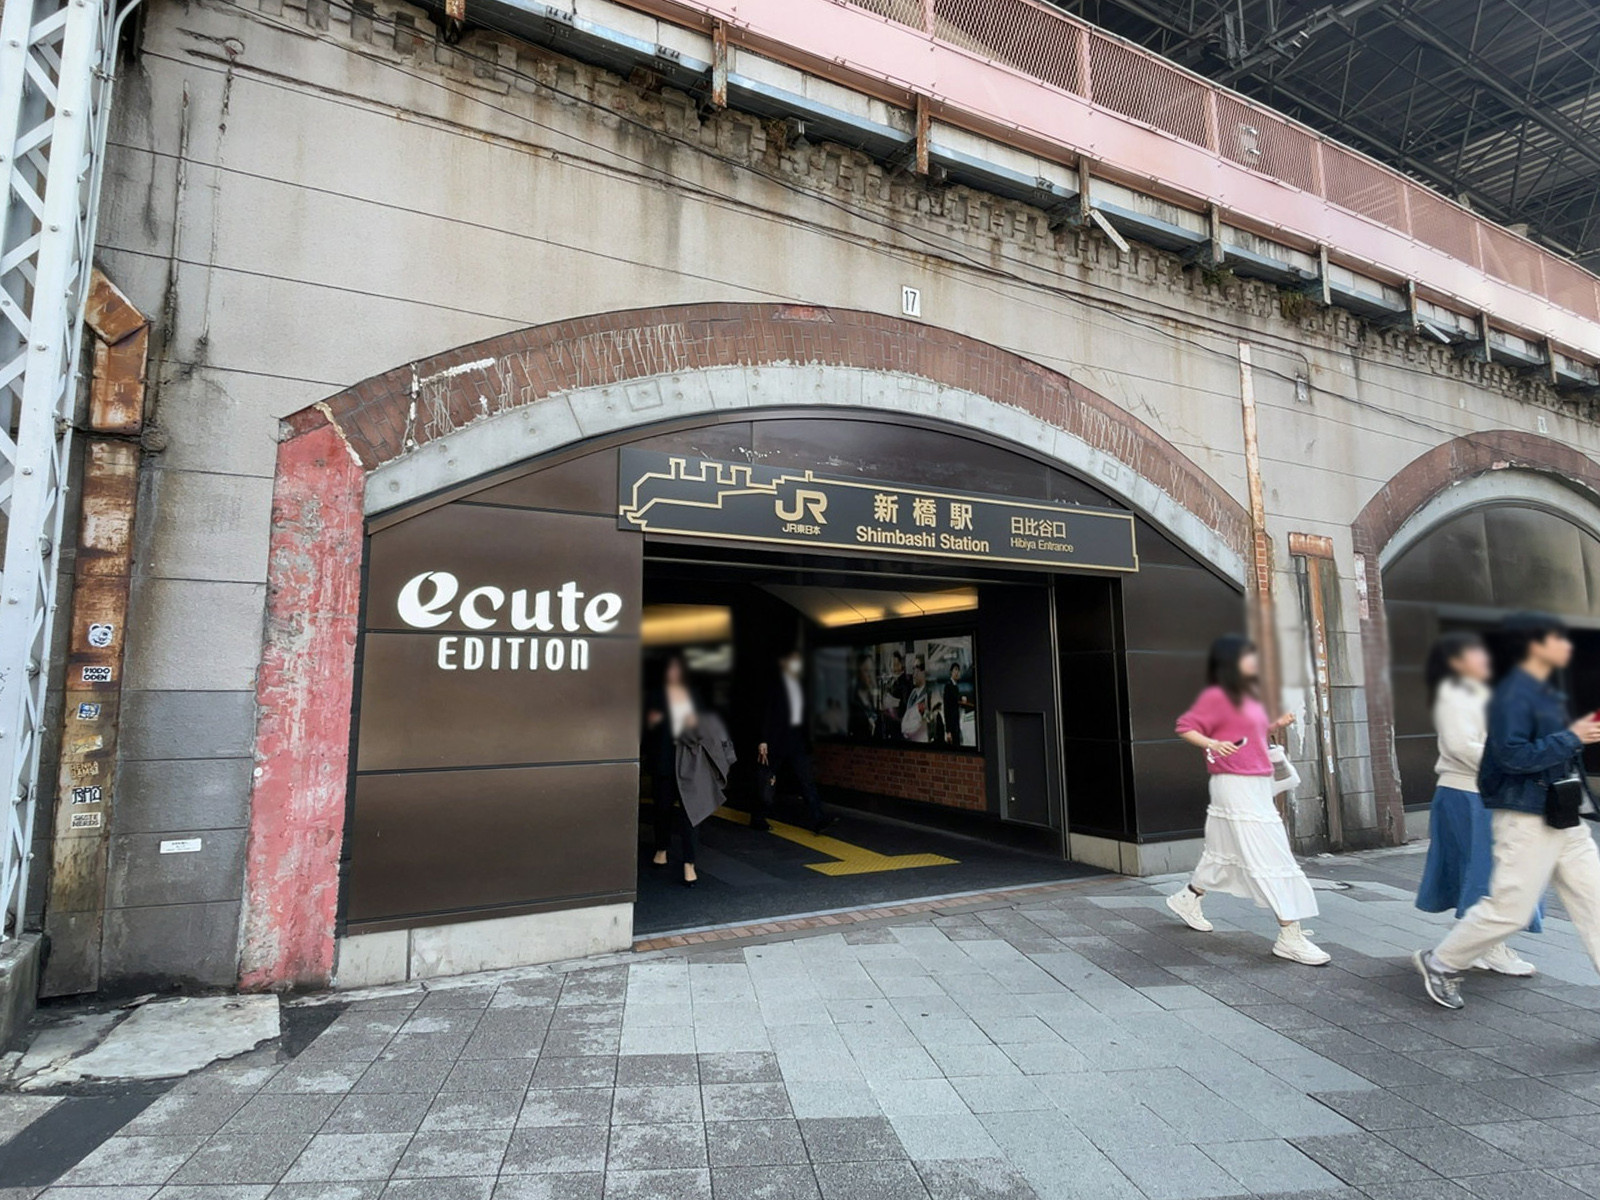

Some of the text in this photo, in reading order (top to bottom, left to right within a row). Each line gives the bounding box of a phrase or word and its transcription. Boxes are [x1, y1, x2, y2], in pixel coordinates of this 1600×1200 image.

[904, 290, 917, 312] 17
[775, 489, 828, 524] JR
[874, 493, 973, 531] 新橋駅
[856, 525, 990, 552] Shimbashi Station
[1011, 516, 1066, 538] 日比谷口
[1010, 537, 1074, 552] Hibiya Entrance
[397, 570, 623, 633] ecute
